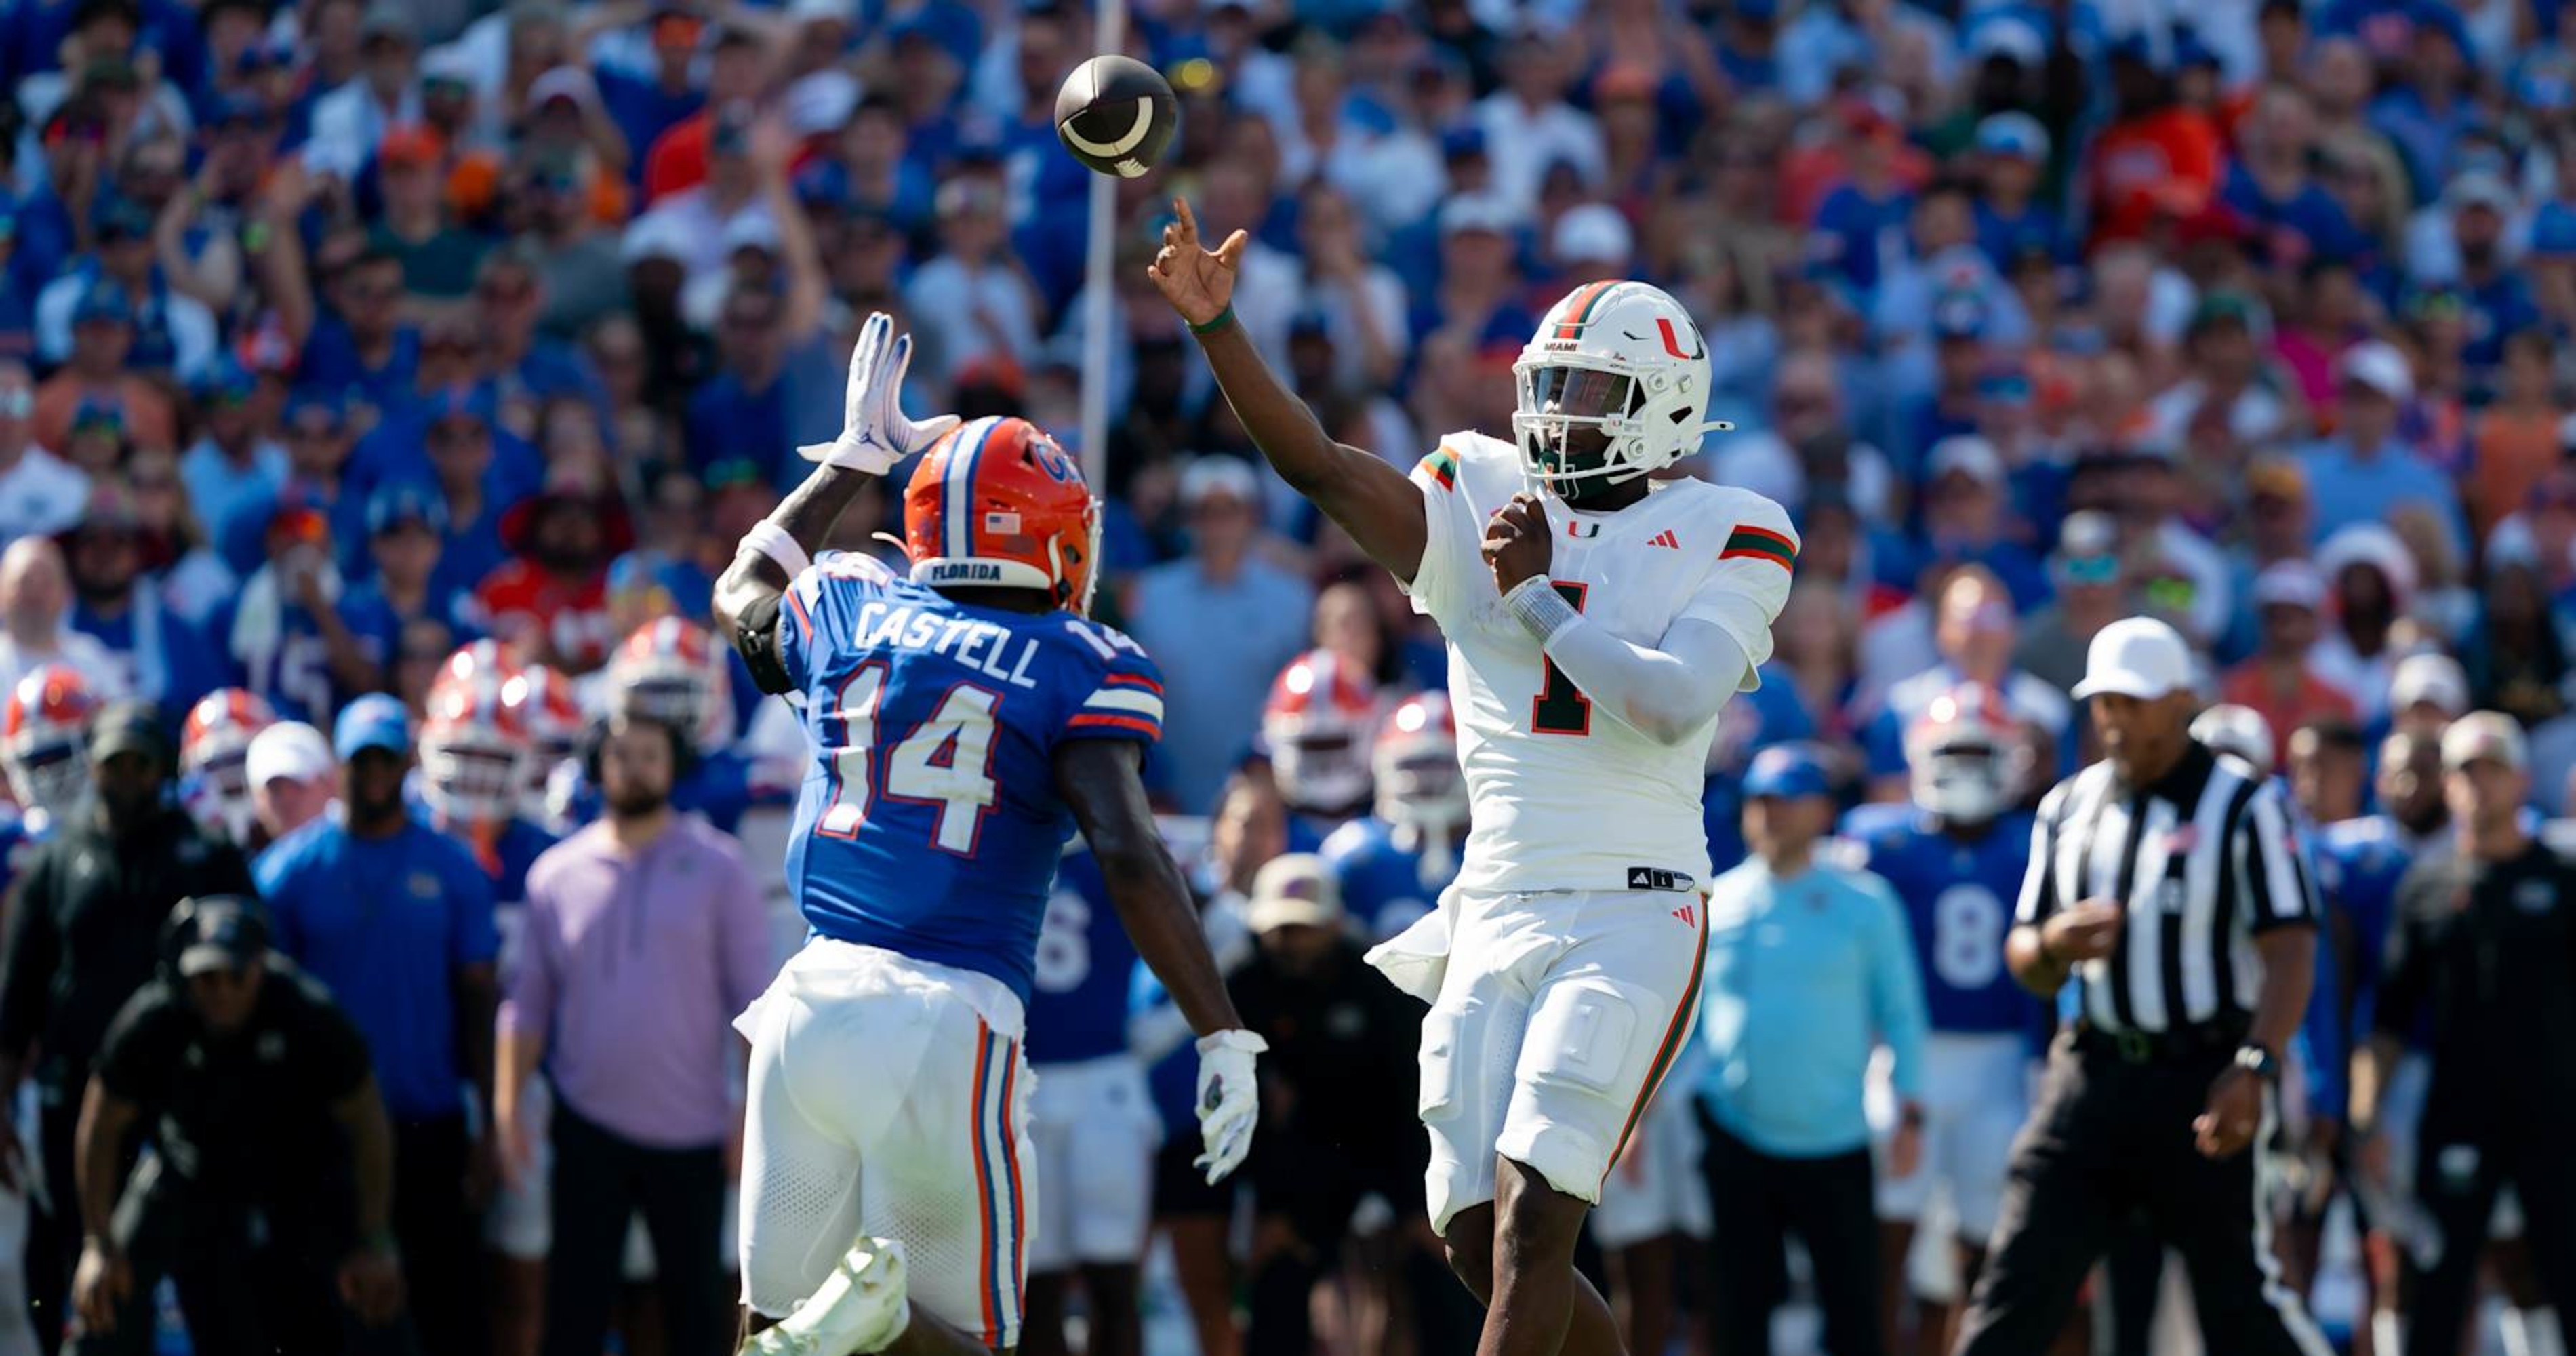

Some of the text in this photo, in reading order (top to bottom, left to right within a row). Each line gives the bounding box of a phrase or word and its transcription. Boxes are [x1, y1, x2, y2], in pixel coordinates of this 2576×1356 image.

[1544, 343, 1578, 351] MIAMI
[1568, 521, 1600, 537] U
[932, 564, 1001, 580] FLORIDA
[854, 603, 1040, 688] CASTELL
[1531, 580, 1592, 736] 1
[815, 660, 1005, 859] 14
[1934, 883, 2005, 989] 8
